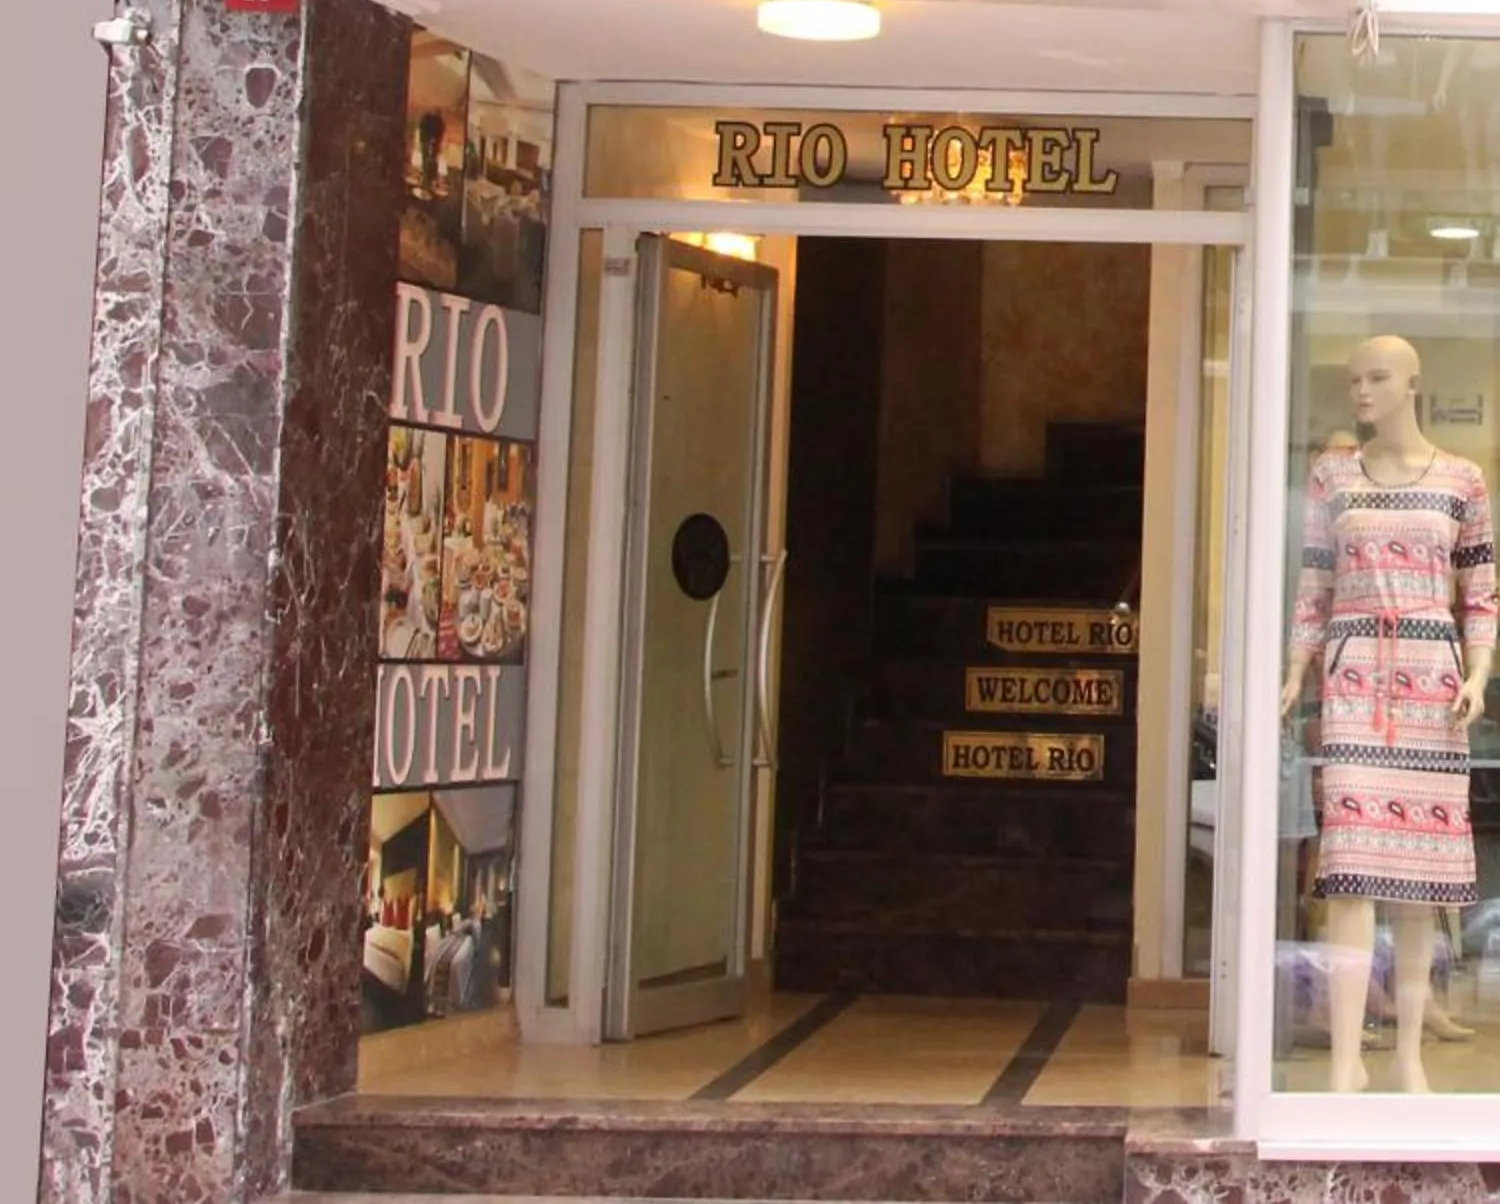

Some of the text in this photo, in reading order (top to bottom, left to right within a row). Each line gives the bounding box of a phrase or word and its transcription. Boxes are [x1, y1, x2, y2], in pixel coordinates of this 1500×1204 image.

[712, 121, 1121, 194] RIO HOTEL
[388, 280, 508, 433] RIO
[997, 621, 1081, 645] HOTEL
[976, 677, 1113, 705] WELCOME
[952, 744, 1040, 770] HOTEL
